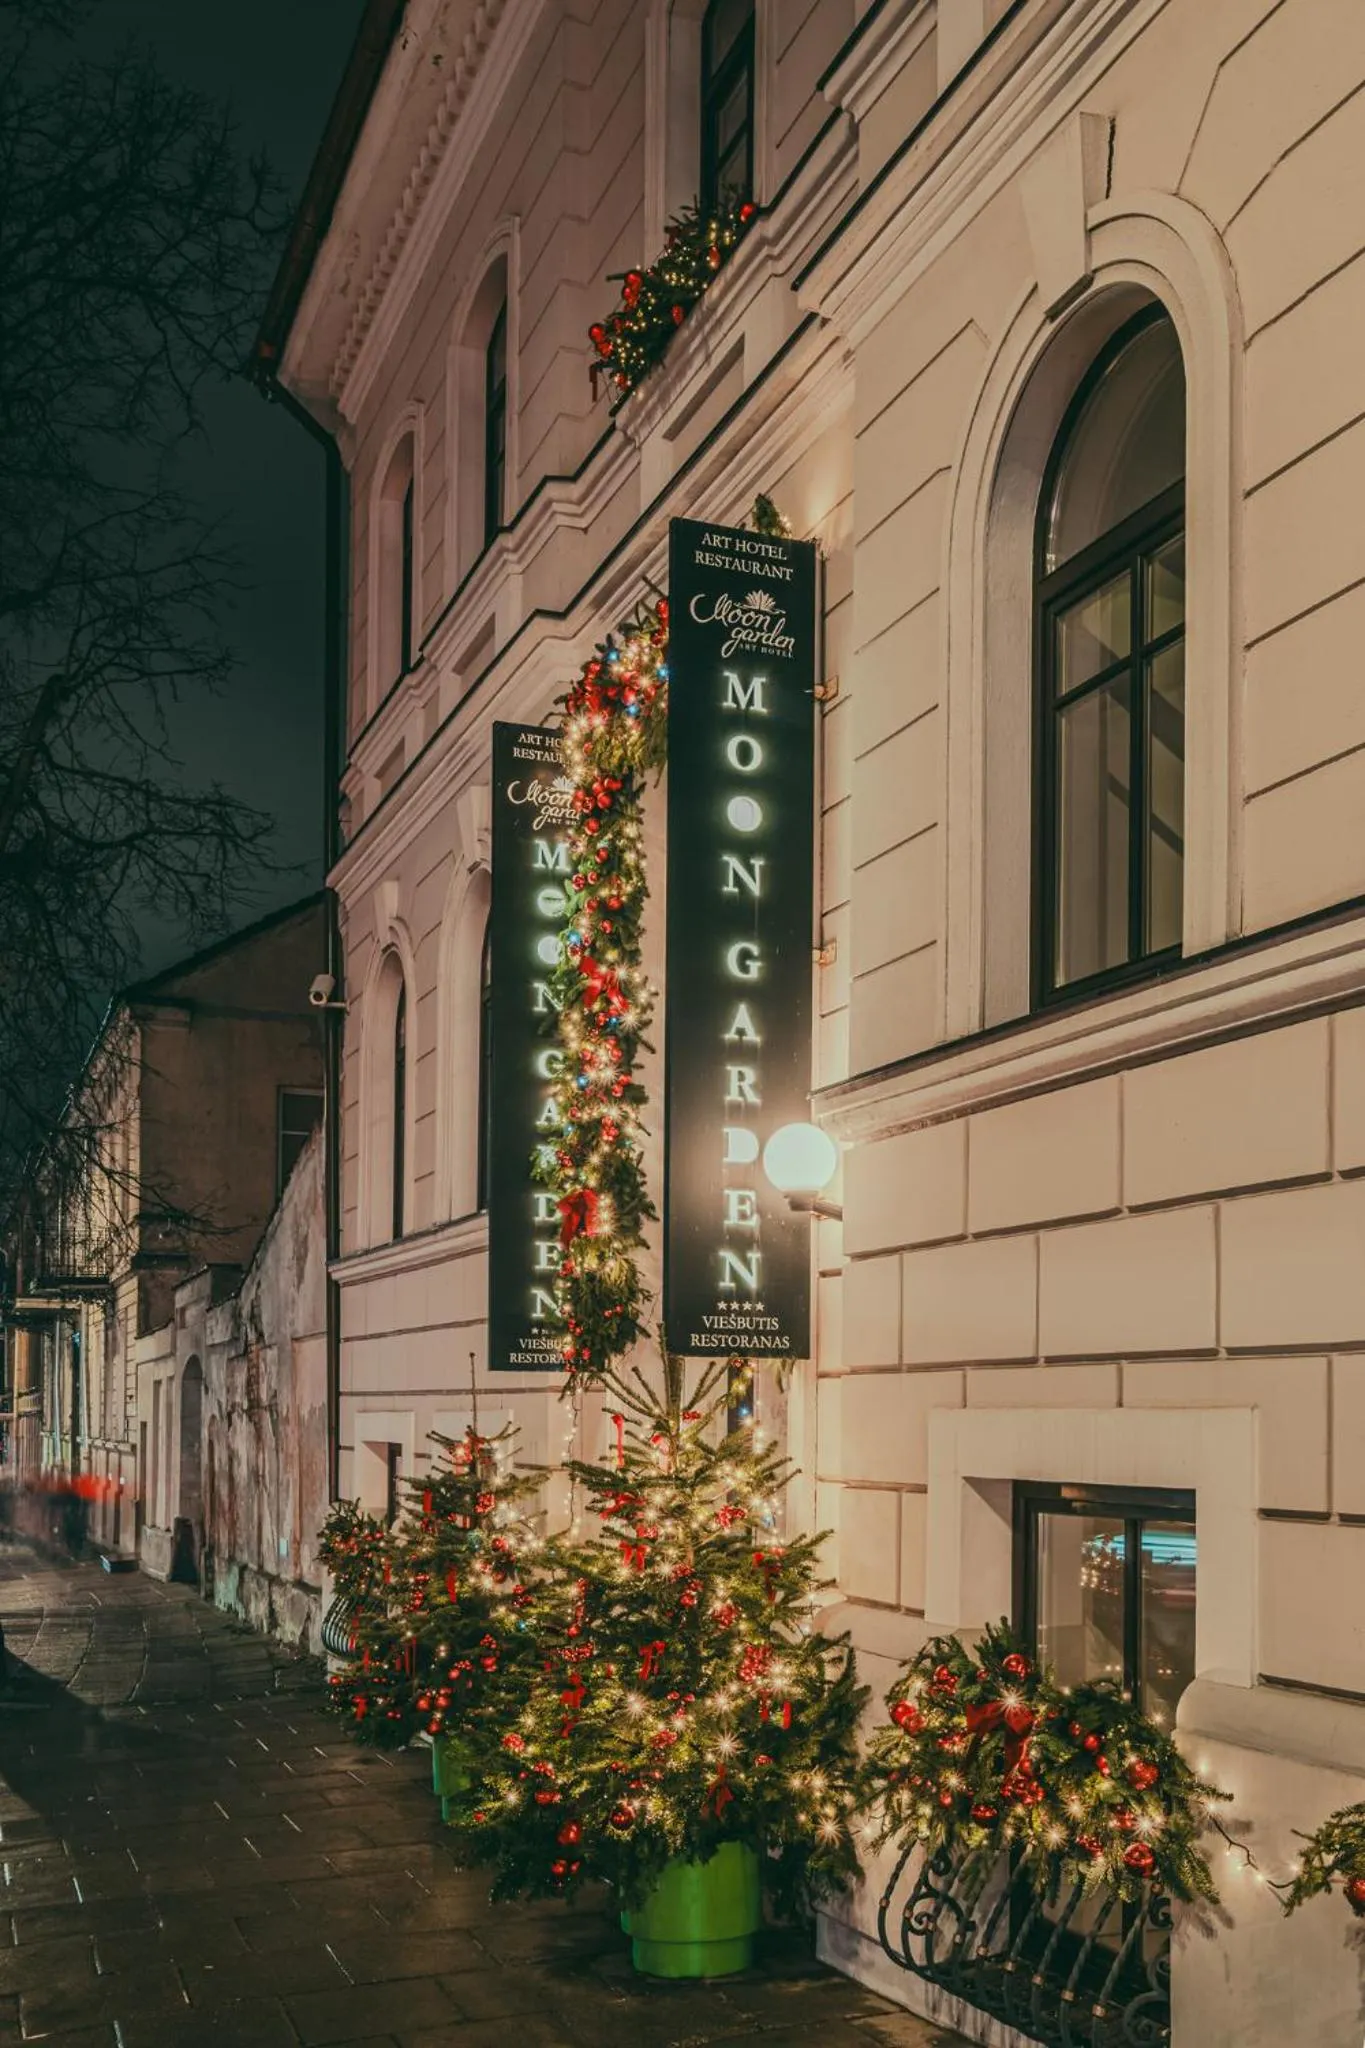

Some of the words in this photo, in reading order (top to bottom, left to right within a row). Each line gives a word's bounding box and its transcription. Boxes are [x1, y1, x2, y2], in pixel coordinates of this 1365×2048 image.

[702, 532, 732, 549] ART
[735, 539, 788, 561] HOTEL
[694, 550, 794, 581] RESTAURANT
[721, 617, 796, 658] garden
[518, 733, 543, 746] ART
[513, 746, 563, 764] RESTAU
[721, 671, 768, 897] MOON
[718, 941, 763, 1289] GARDEN
[702, 1312, 779, 1331] VIEŠBUTIS
[519, 1336, 562, 1350] VIEŠBU
[690, 1333, 790, 1349] RESTORANAS
